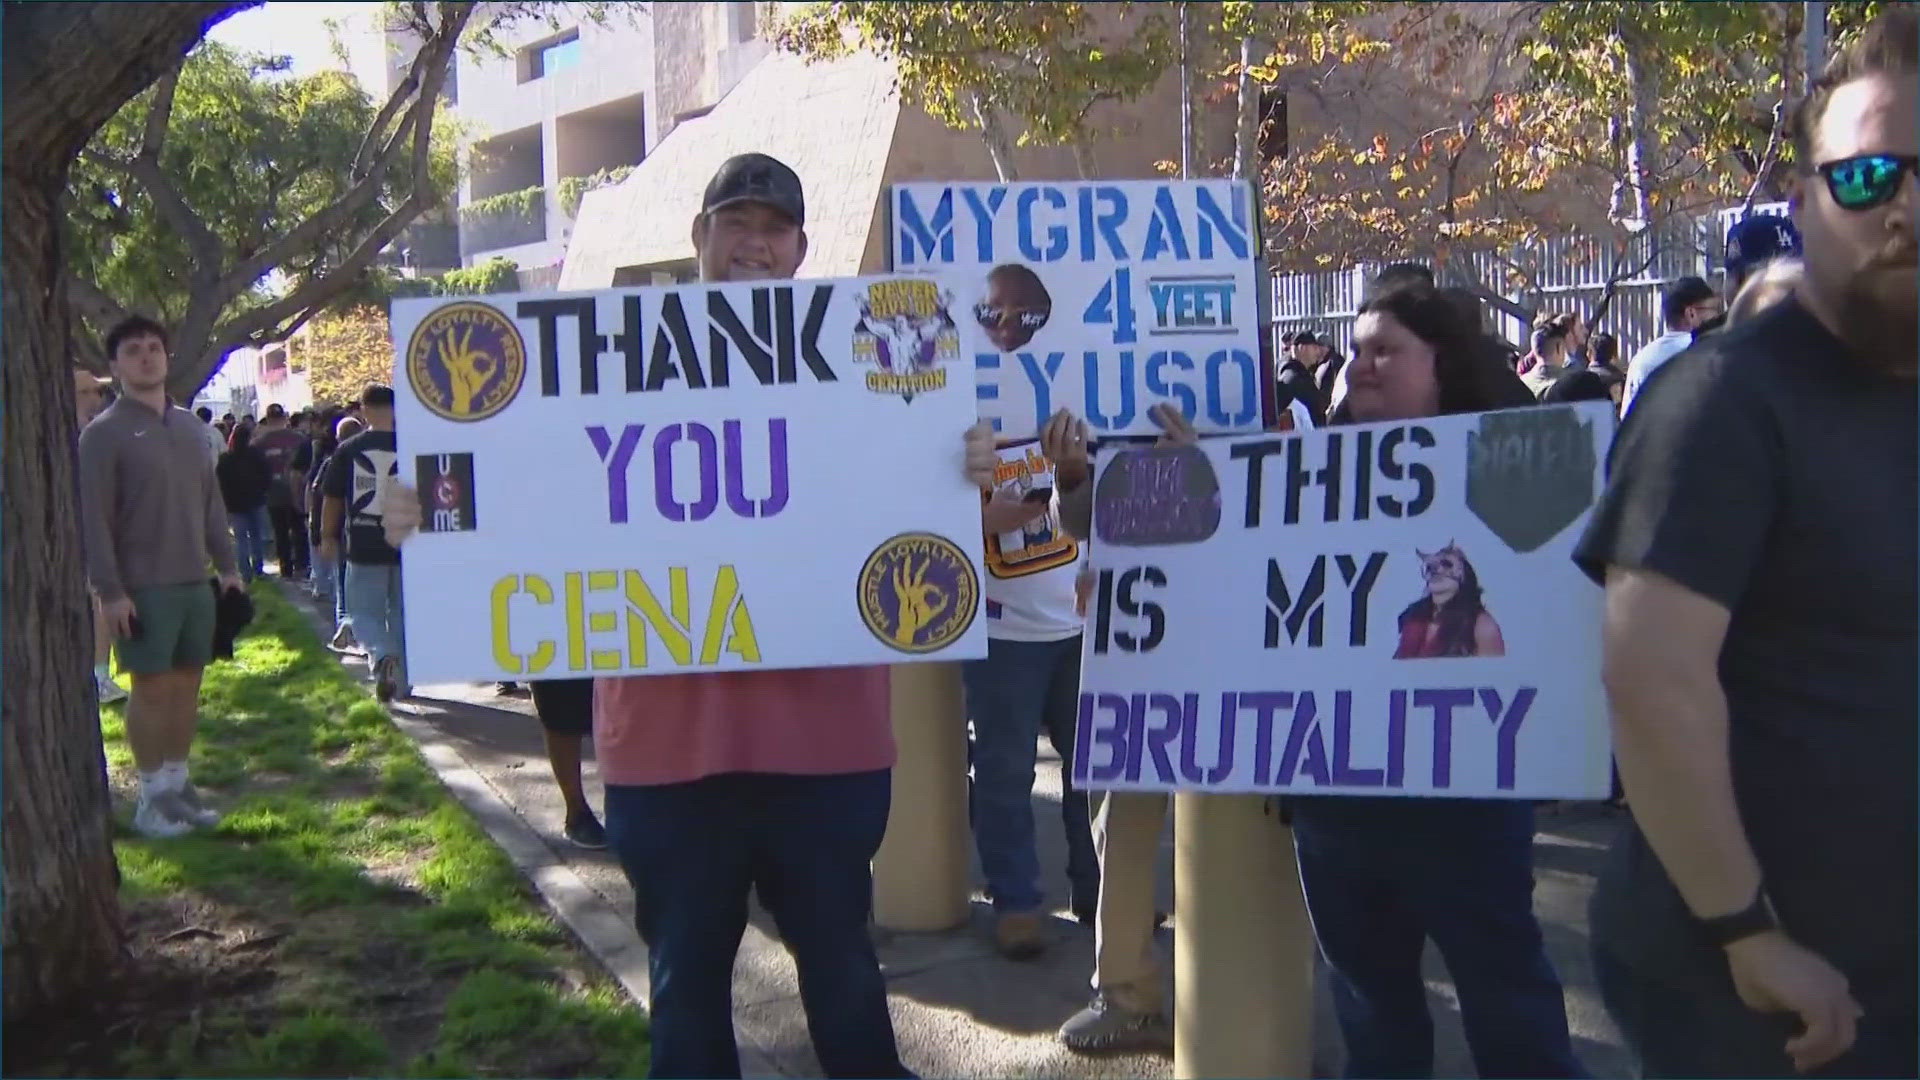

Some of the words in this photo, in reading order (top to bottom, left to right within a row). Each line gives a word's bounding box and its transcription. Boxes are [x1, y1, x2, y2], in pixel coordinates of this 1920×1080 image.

[900, 186, 1249, 264] MYGRAN
[516, 285, 838, 397] THANK
[1083, 267, 1137, 344] 4
[1149, 283, 1237, 327] YEET
[585, 418, 790, 524] YOU
[1230, 426, 1436, 529] THIS
[490, 564, 763, 675] CENA
[1094, 566, 1168, 655] IS
[1263, 551, 1389, 650] MY
[1073, 686, 1538, 790] BRUTALITY
